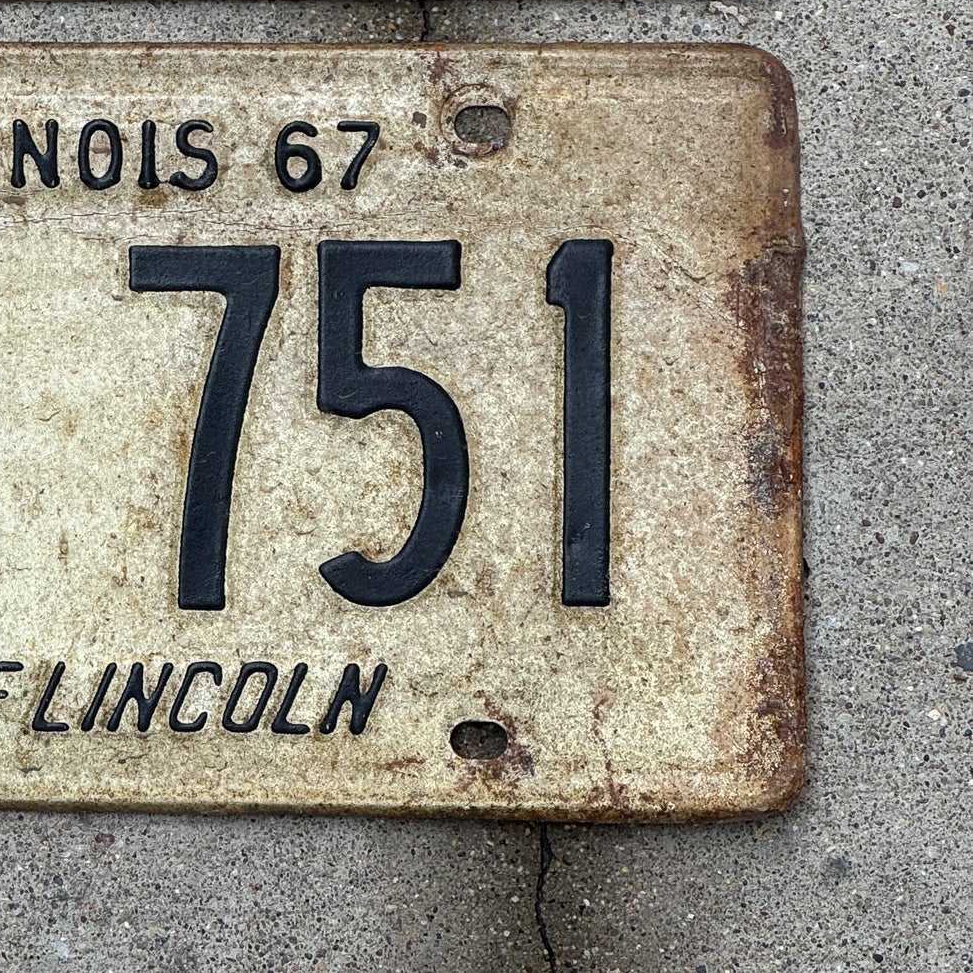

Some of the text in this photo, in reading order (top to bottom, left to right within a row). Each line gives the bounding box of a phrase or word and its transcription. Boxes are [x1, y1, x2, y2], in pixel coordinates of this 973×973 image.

[273, 120, 382, 194] 67
[127, 238, 616, 613] 751
[30, 660, 390, 737] LINCOLN
